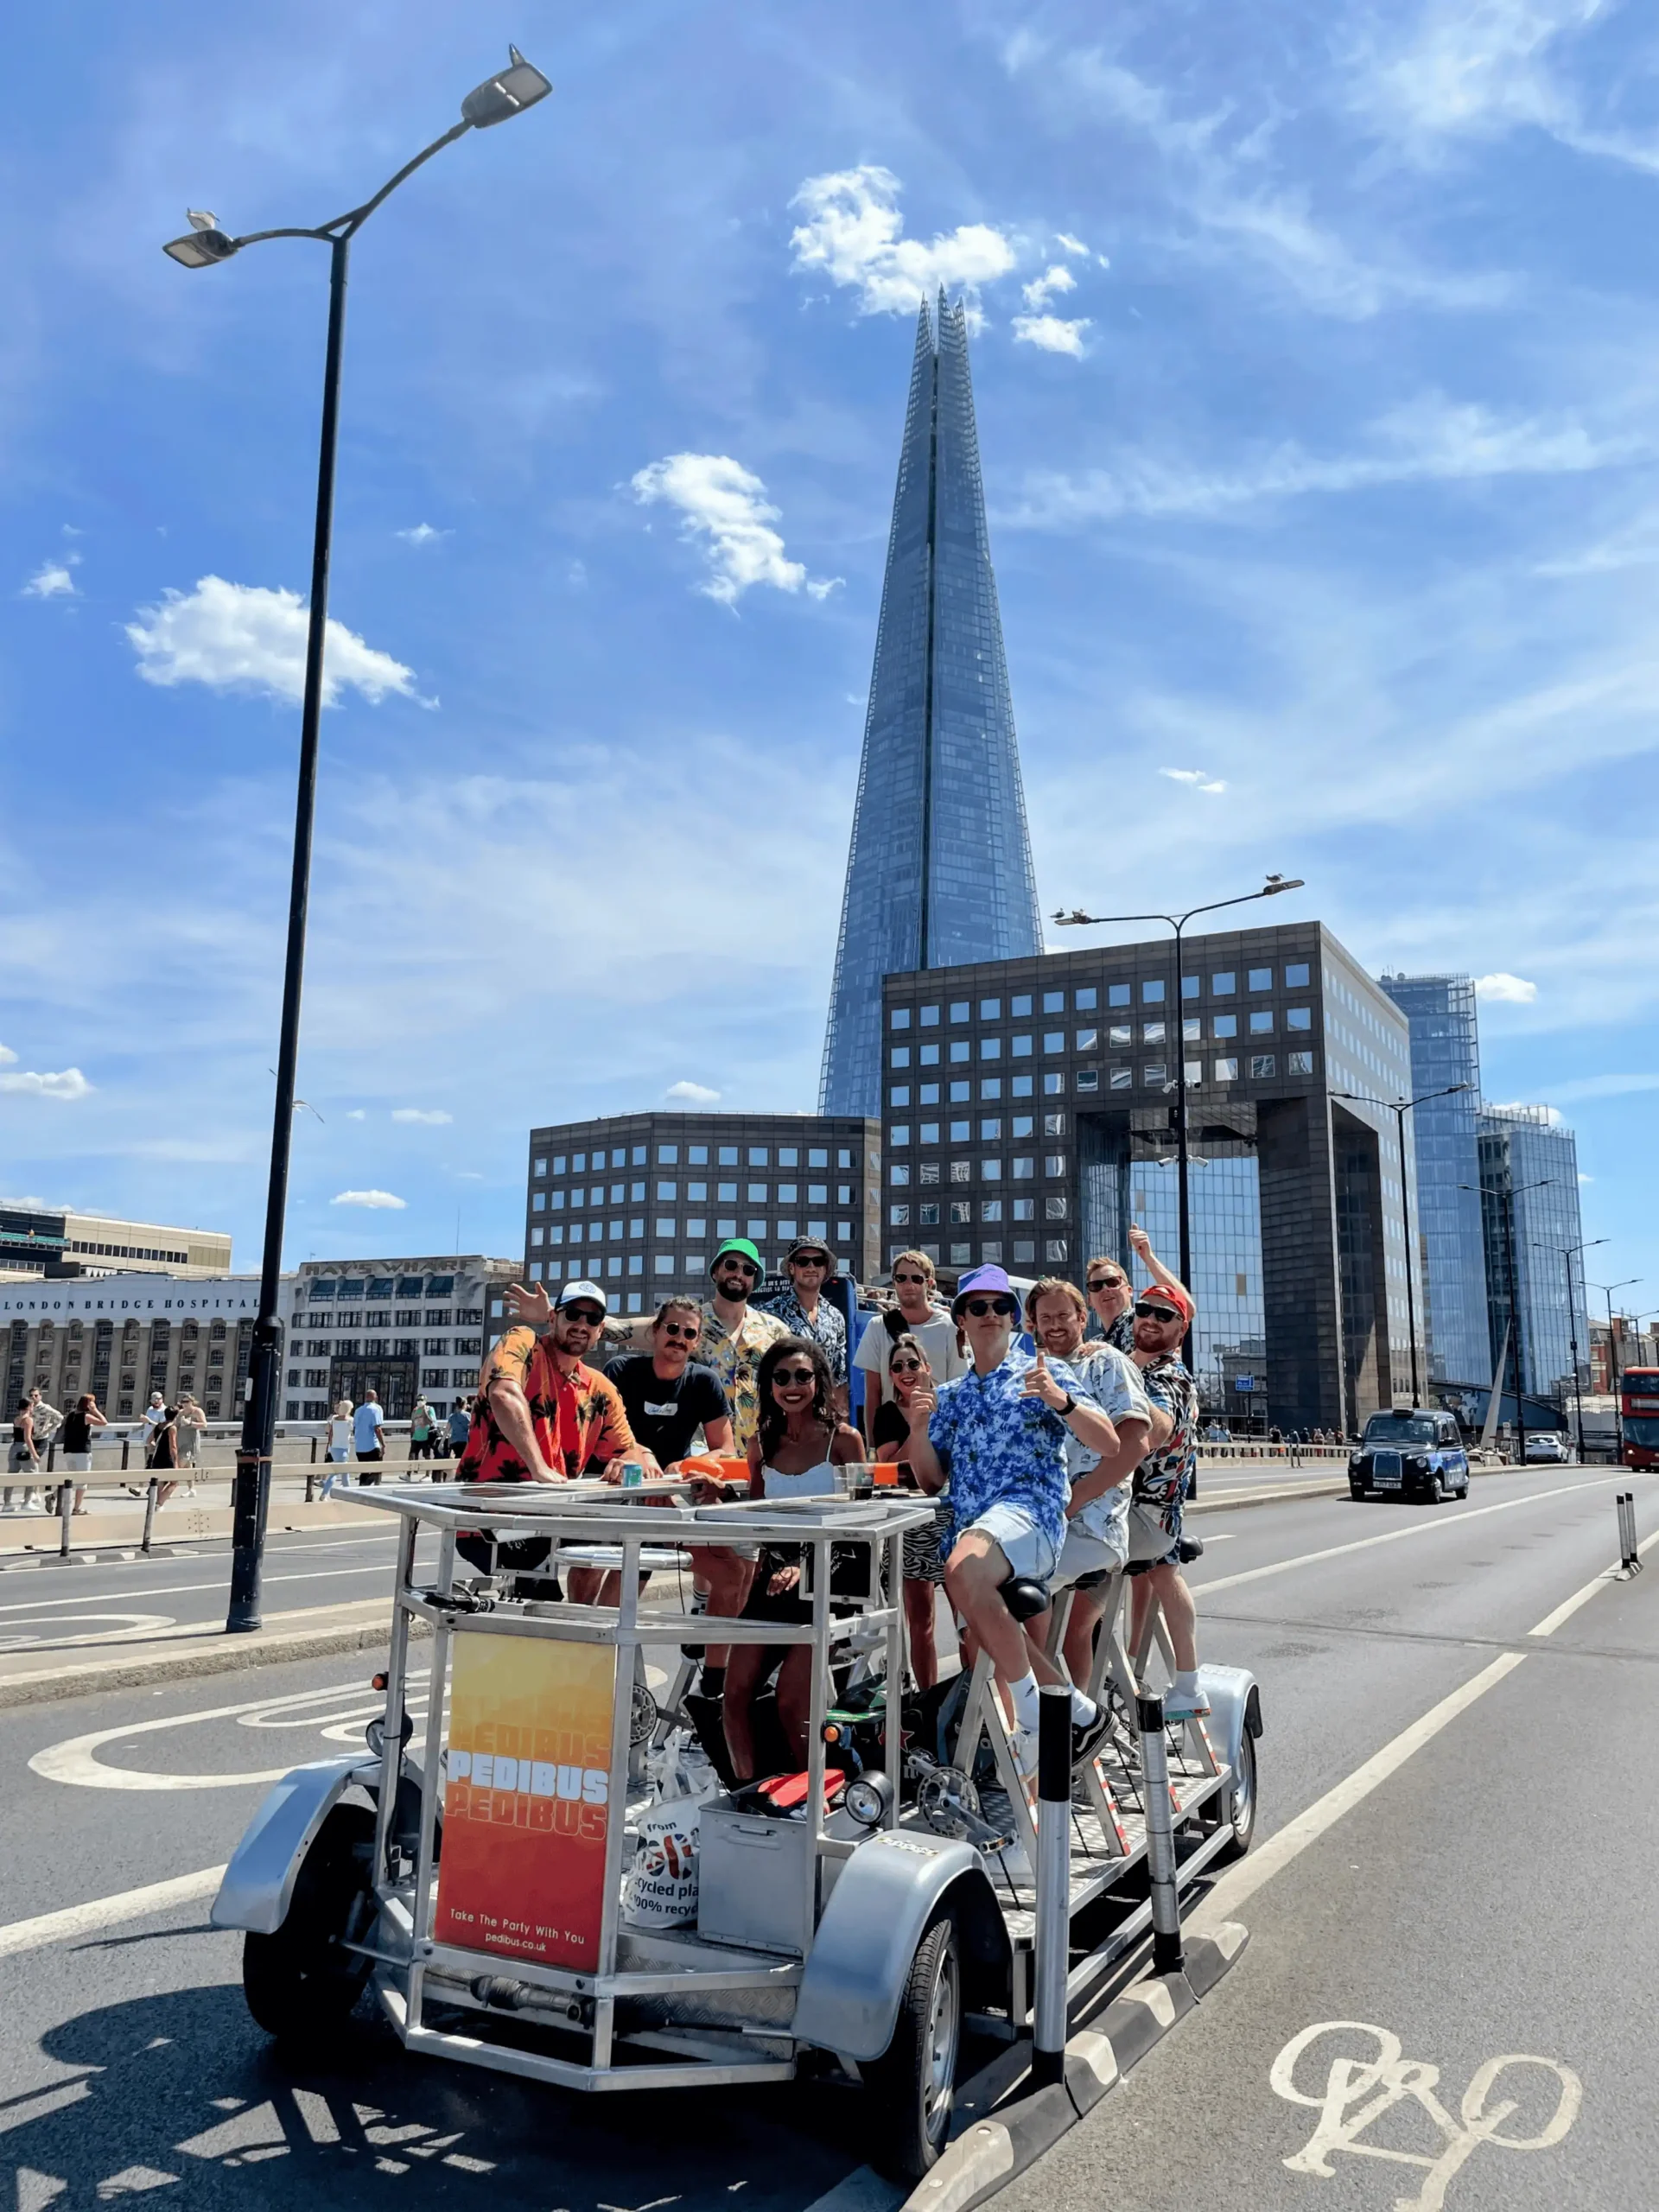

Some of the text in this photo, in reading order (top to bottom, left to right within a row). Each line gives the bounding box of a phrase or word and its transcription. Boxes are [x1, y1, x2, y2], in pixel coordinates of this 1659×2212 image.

[305, 1258, 477, 1276] HAY'S WHARF
[3, 1298, 259, 1311] LONDON BRIDGE HOSPITAL
[447, 1749, 609, 1805] PEDIBUS
[445, 1782, 607, 1841] PEDIBUS
[646, 1821, 677, 1833] from
[635, 1877, 675, 1897] cycled
[450, 1908, 585, 1945] Take The Party With You
[485, 1932, 547, 1953] pedibus.co.uk
